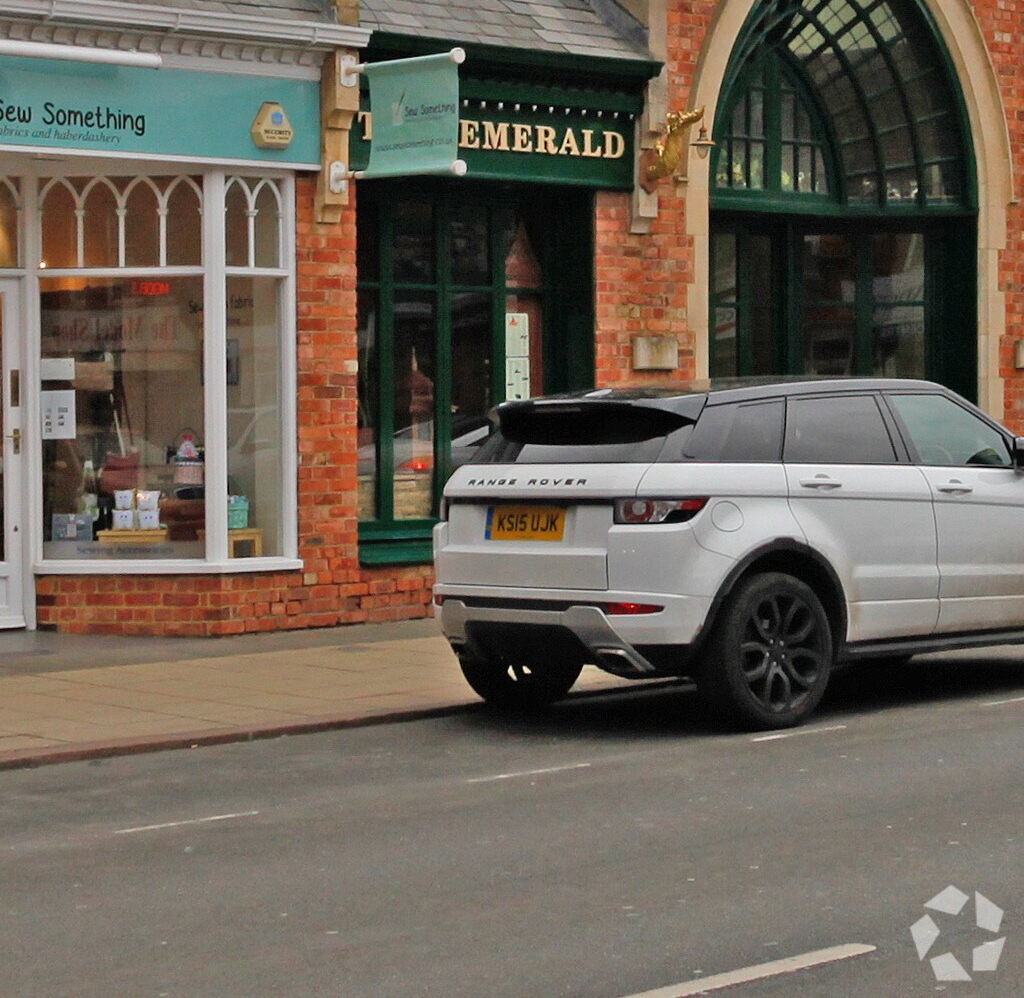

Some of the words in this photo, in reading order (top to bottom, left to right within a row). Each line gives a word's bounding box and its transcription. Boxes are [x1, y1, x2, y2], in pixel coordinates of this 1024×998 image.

[42, 101, 146, 137] Something
[31, 128, 52, 139] and
[54, 129, 121, 144] haberdashery
[458, 118, 625, 160] EMERALD
[527, 478, 587, 486] ROVER
[497, 513, 529, 532] KS15
[531, 513, 560, 532] UJK
